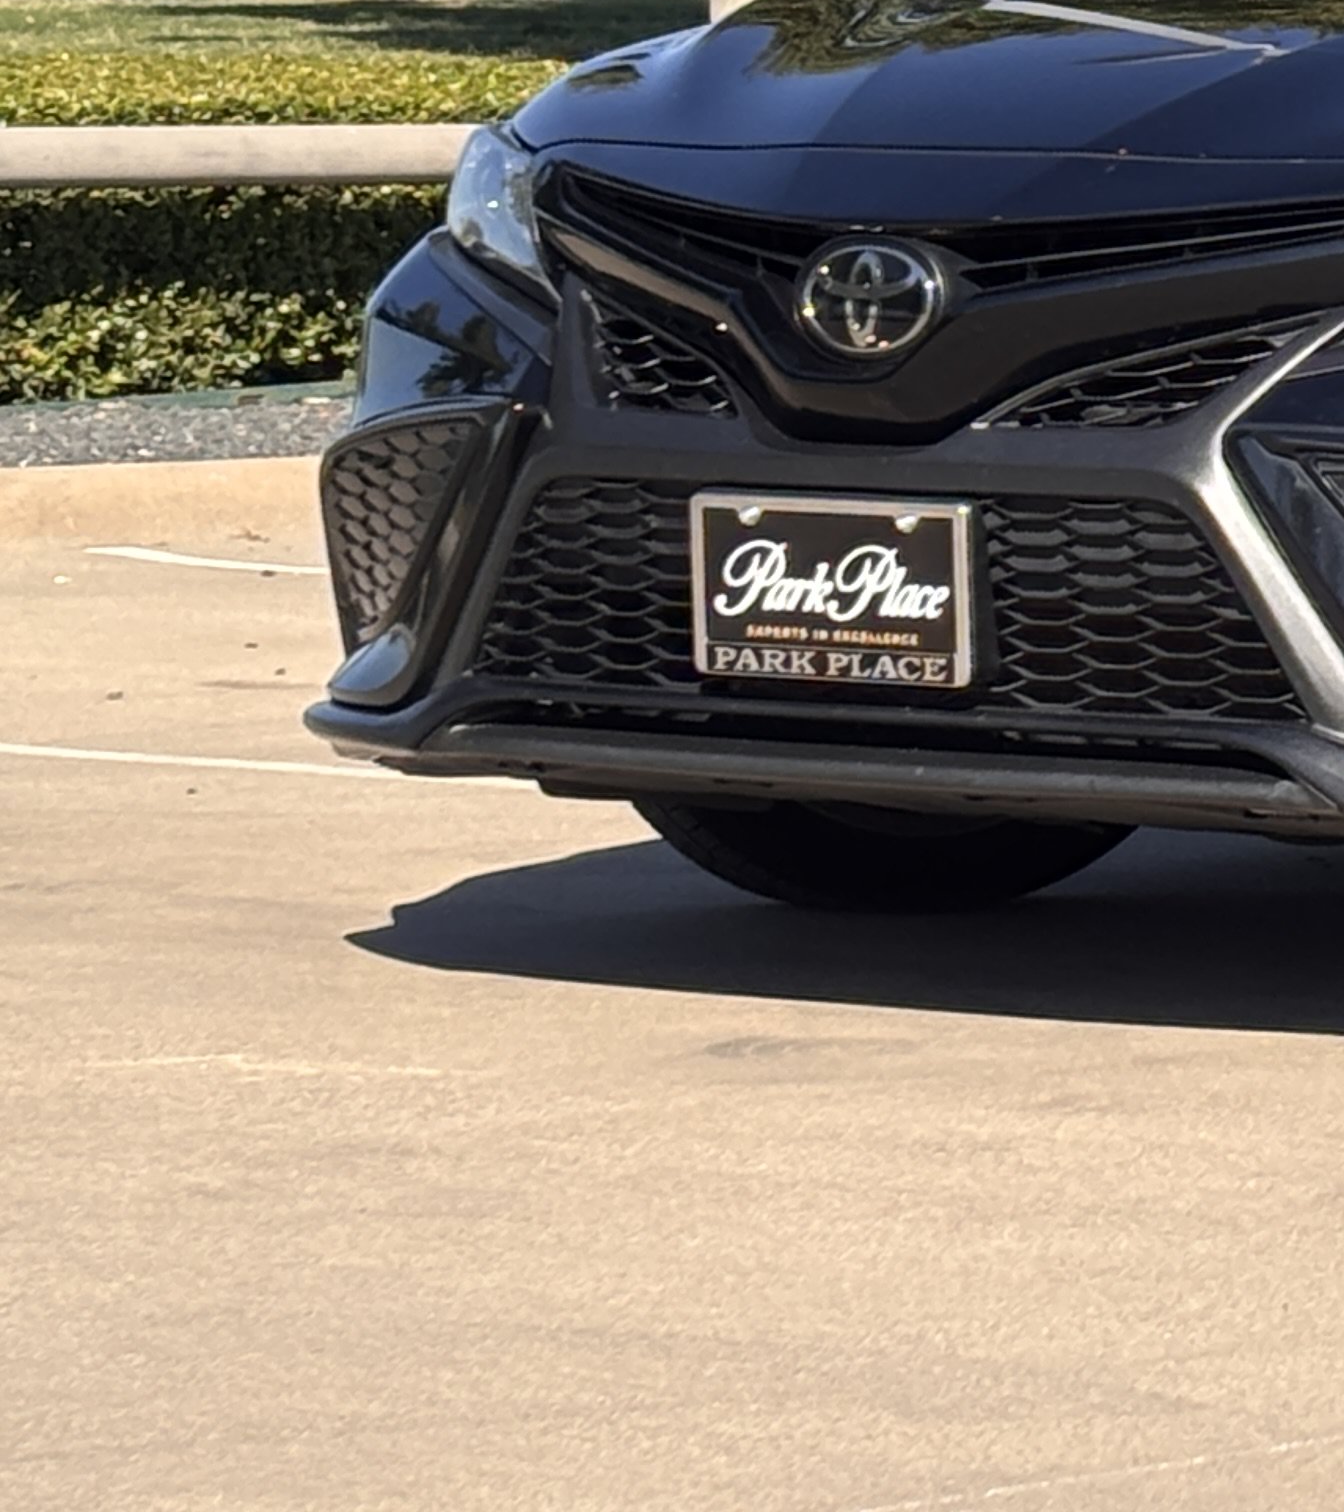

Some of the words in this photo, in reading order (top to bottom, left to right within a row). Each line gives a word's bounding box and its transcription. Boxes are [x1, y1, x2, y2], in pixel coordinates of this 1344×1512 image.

[713, 538, 835, 617] Park
[825, 544, 950, 623] Place
[713, 646, 817, 676] PARK
[825, 652, 949, 682] PLACE
